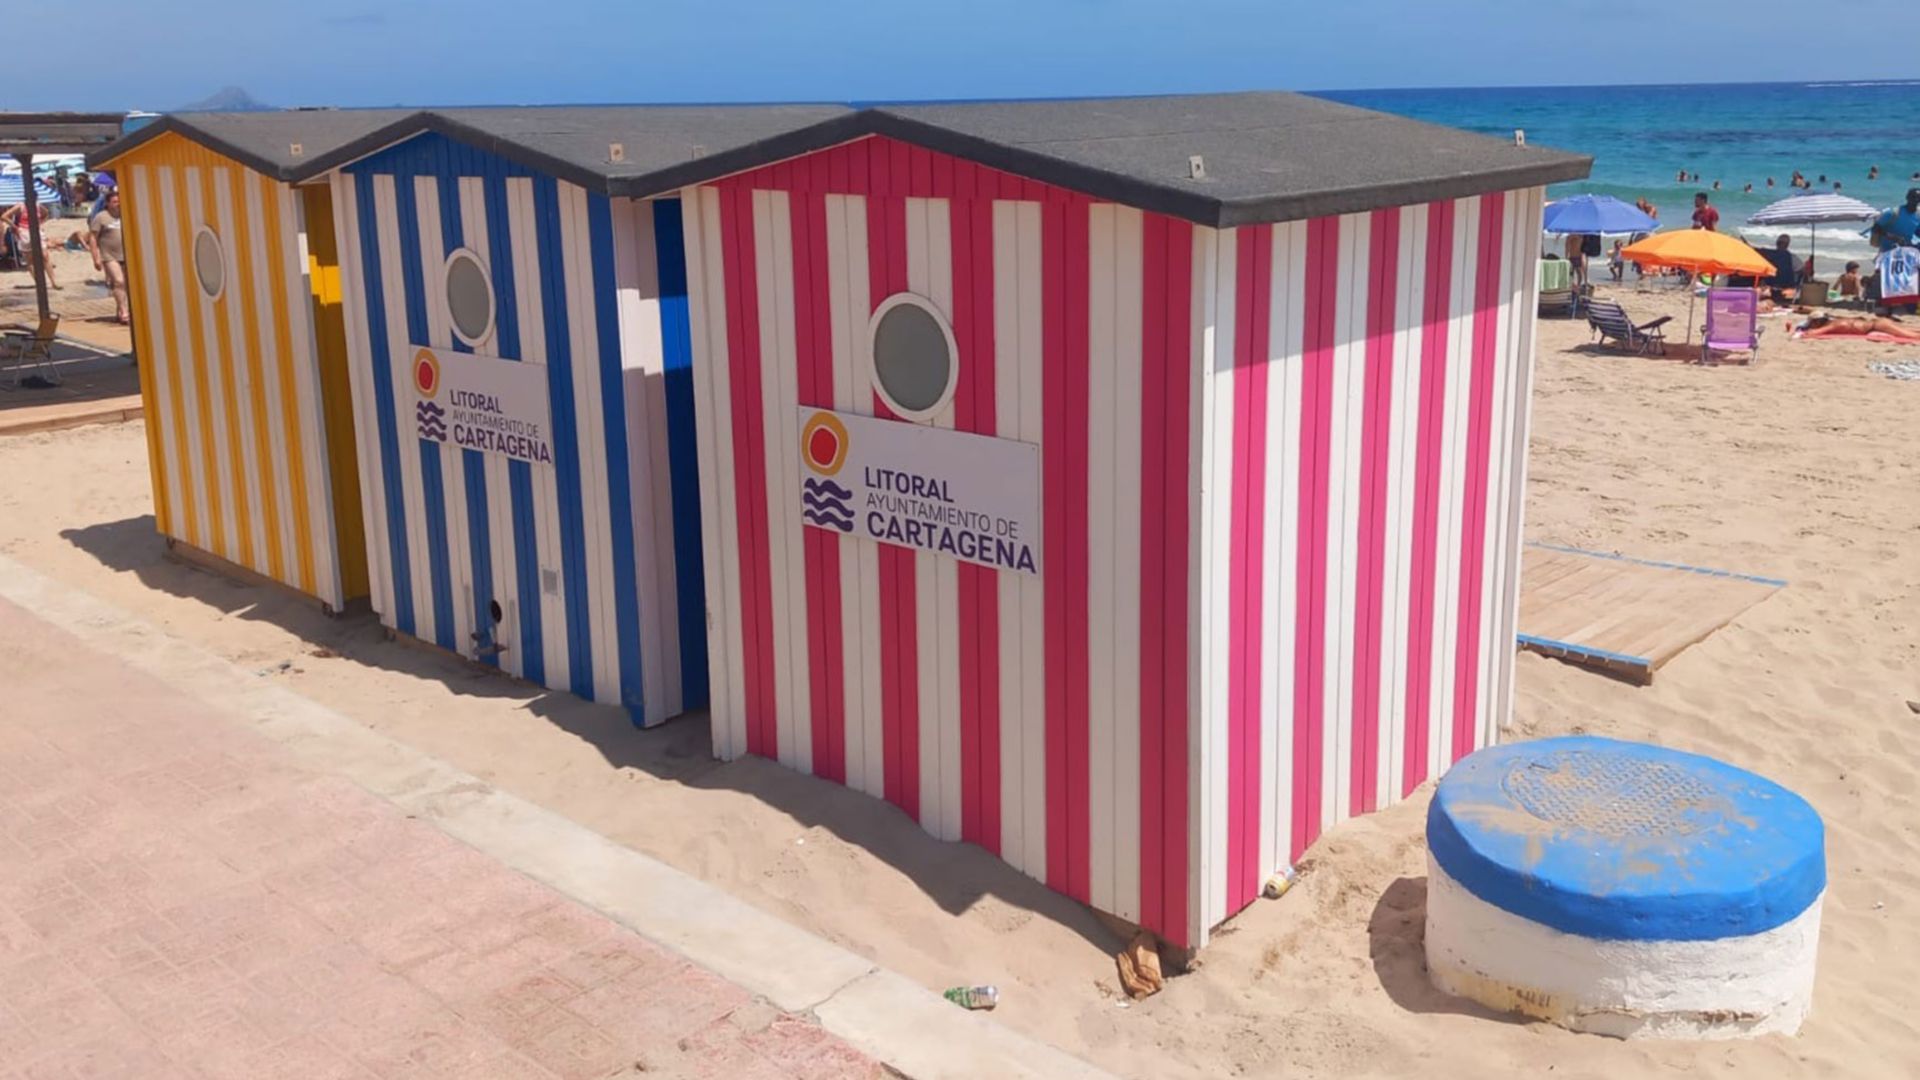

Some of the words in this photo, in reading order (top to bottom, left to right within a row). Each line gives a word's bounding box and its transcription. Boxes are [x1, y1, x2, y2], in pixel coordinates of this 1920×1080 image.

[1891, 260, 1904, 275] 10
[450, 389, 503, 414] LITORAL
[452, 410, 524, 435] AYUNTAMIENTO
[526, 422, 539, 438] DE
[454, 424, 551, 463] CARTAGENA
[865, 466, 954, 503] LITORAL
[866, 493, 991, 532] AYUNTAMIENTO
[996, 518, 1019, 539] DE
[867, 511, 1037, 574] CARTAGENA
